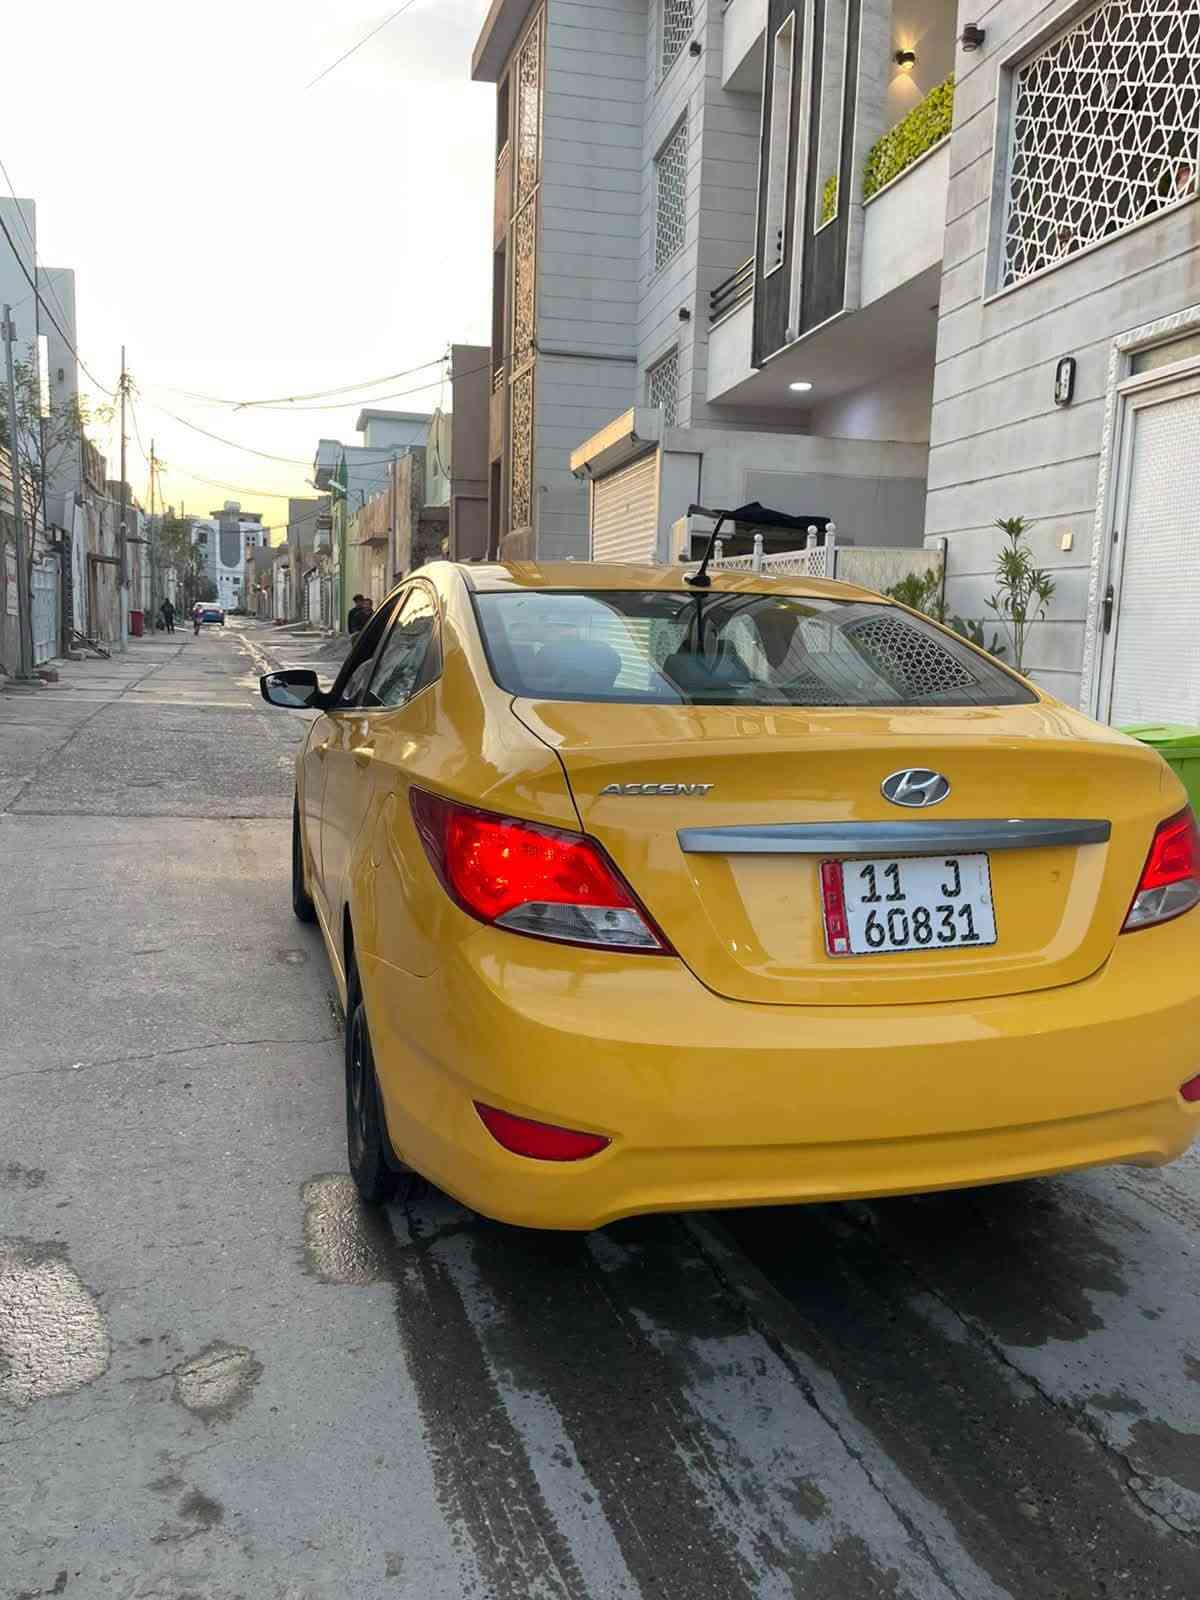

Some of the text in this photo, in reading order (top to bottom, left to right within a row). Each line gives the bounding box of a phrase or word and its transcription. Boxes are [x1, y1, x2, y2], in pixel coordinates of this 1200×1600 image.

[598, 783, 715, 796] ACCENT
[860, 863, 906, 903] 11
[941, 859, 962, 898] J
[865, 903, 980, 947] 60831
